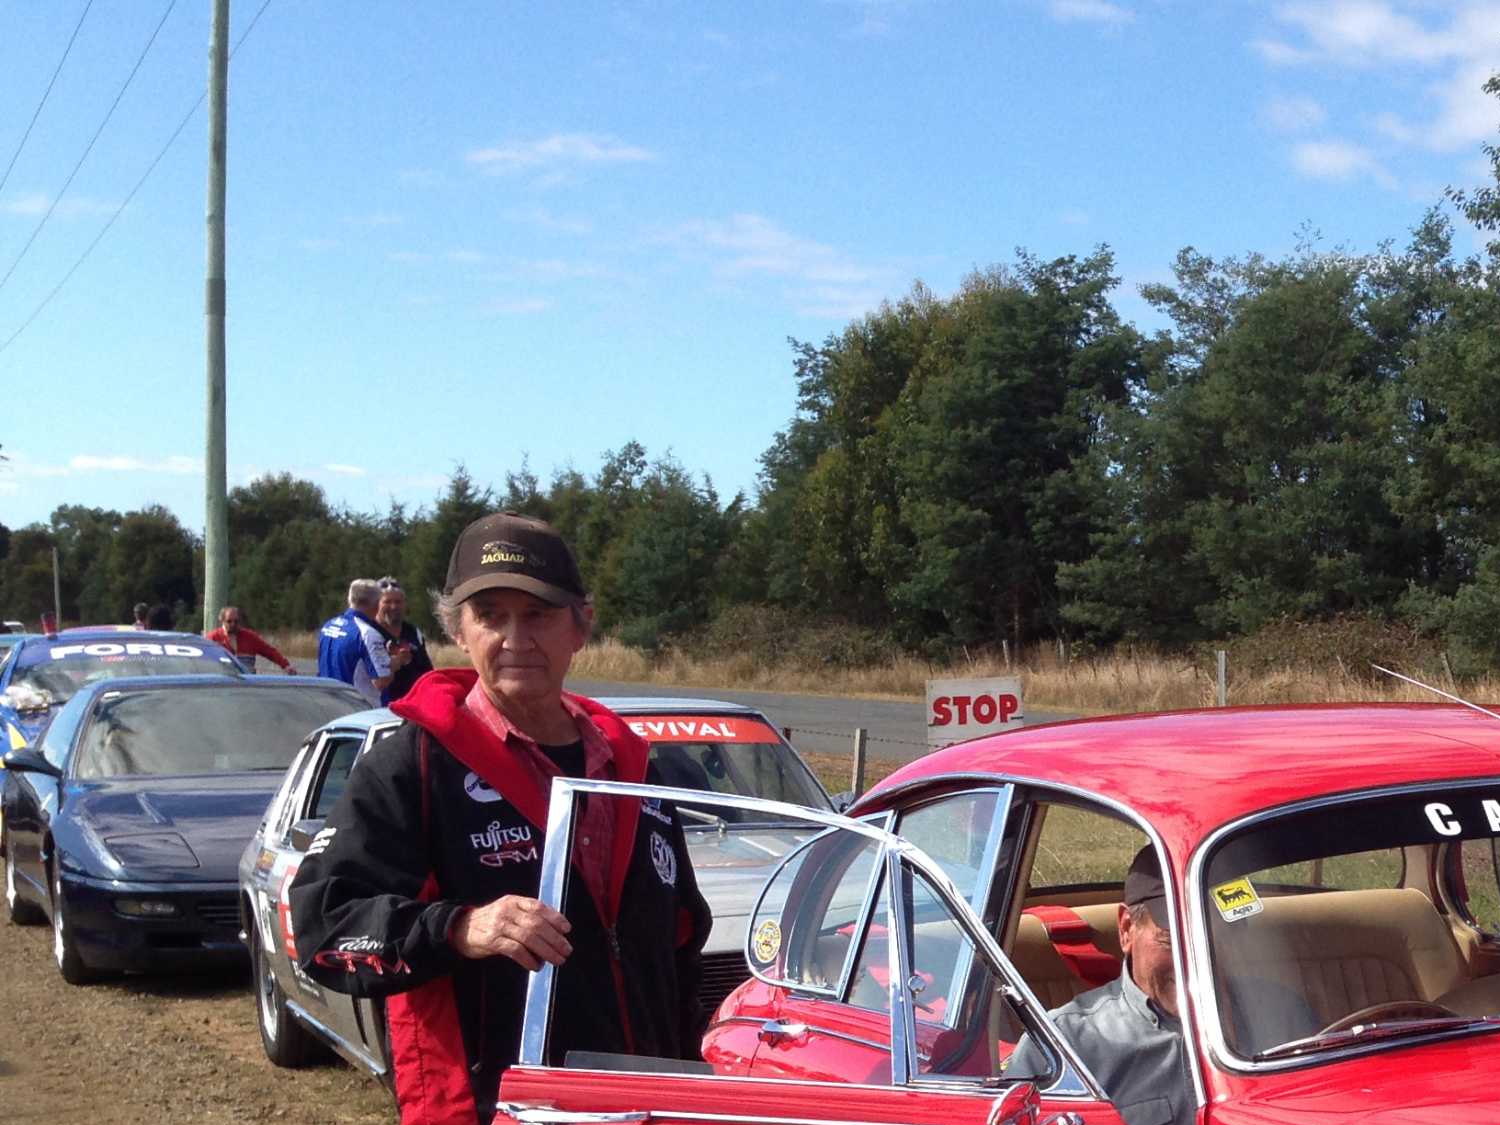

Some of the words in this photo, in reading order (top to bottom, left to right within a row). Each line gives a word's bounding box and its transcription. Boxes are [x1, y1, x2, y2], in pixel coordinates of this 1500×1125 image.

[50, 643, 204, 660] FORD
[932, 693, 1019, 727] STOP
[470, 820, 532, 851] FUJITSU
